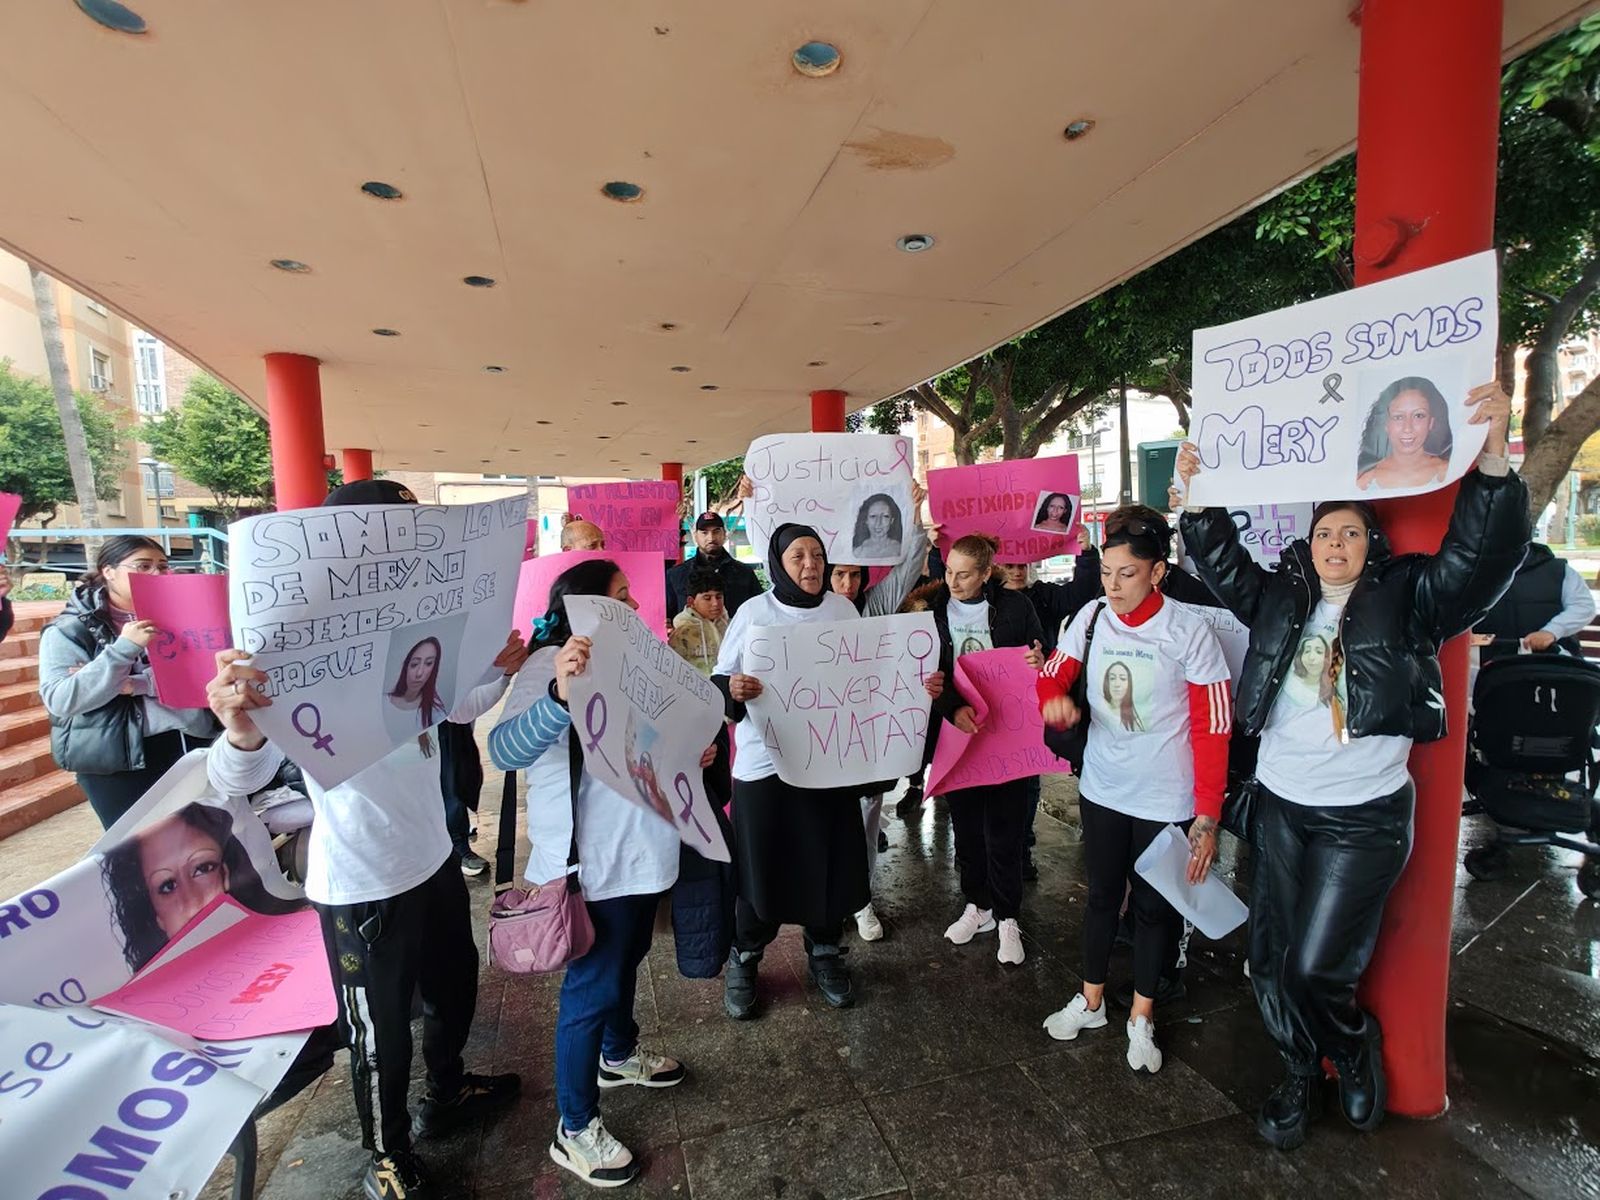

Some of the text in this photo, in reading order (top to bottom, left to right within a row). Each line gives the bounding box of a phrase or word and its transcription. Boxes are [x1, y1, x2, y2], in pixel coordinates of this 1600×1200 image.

[1204, 296, 1483, 392] TODOS SOMOS
[1198, 405, 1339, 470] MERY
[751, 442, 890, 482] Justicia
[977, 466, 1026, 493] FUE
[572, 484, 597, 499] TU
[606, 482, 679, 500] ALIENTO
[752, 486, 835, 515] Para
[252, 506, 449, 568] SOMOS
[462, 505, 492, 542] LA
[641, 509, 662, 527] EN
[994, 534, 1066, 557] UEMADA
[243, 572, 309, 615] DE
[426, 550, 466, 585] NO
[417, 586, 464, 619] QUE
[473, 572, 497, 604] SE
[765, 707, 928, 770] A MATAR
